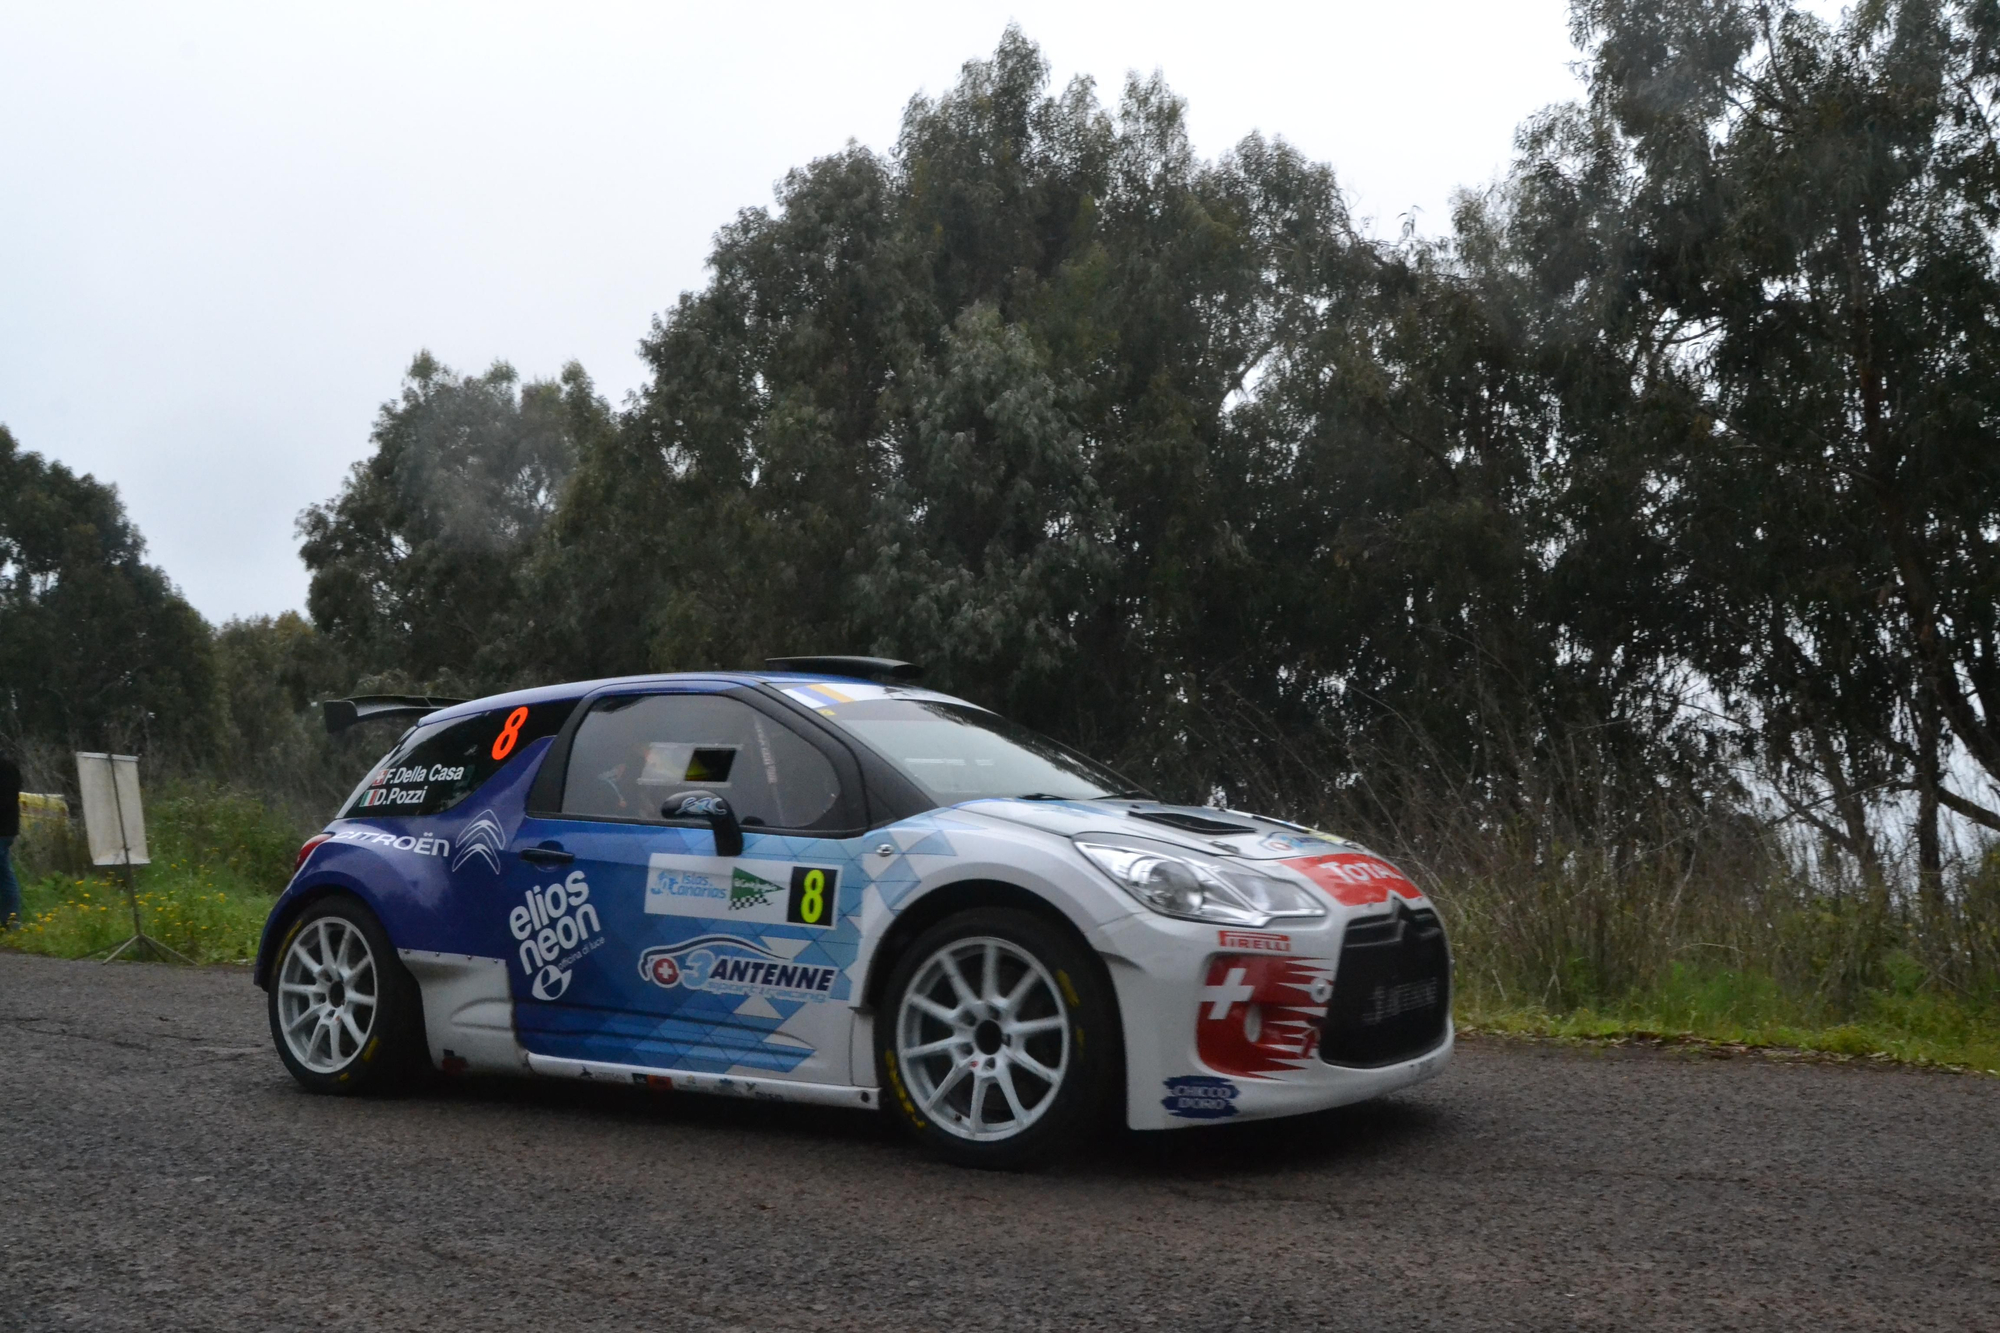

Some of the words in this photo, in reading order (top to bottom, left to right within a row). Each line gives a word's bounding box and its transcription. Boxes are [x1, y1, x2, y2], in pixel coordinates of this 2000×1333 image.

[491, 706, 529, 761] 8
[382, 765, 427, 785] F.Della
[429, 763, 465, 782] Casa
[374, 785, 429, 806] D.Pozzi
[509, 870, 590, 941] elios
[669, 881, 728, 900] Canarias
[800, 869, 825, 924] 8
[519, 903, 601, 976] neon
[1218, 930, 1291, 952] PIRELLI
[709, 958, 835, 991] ANTENNE
